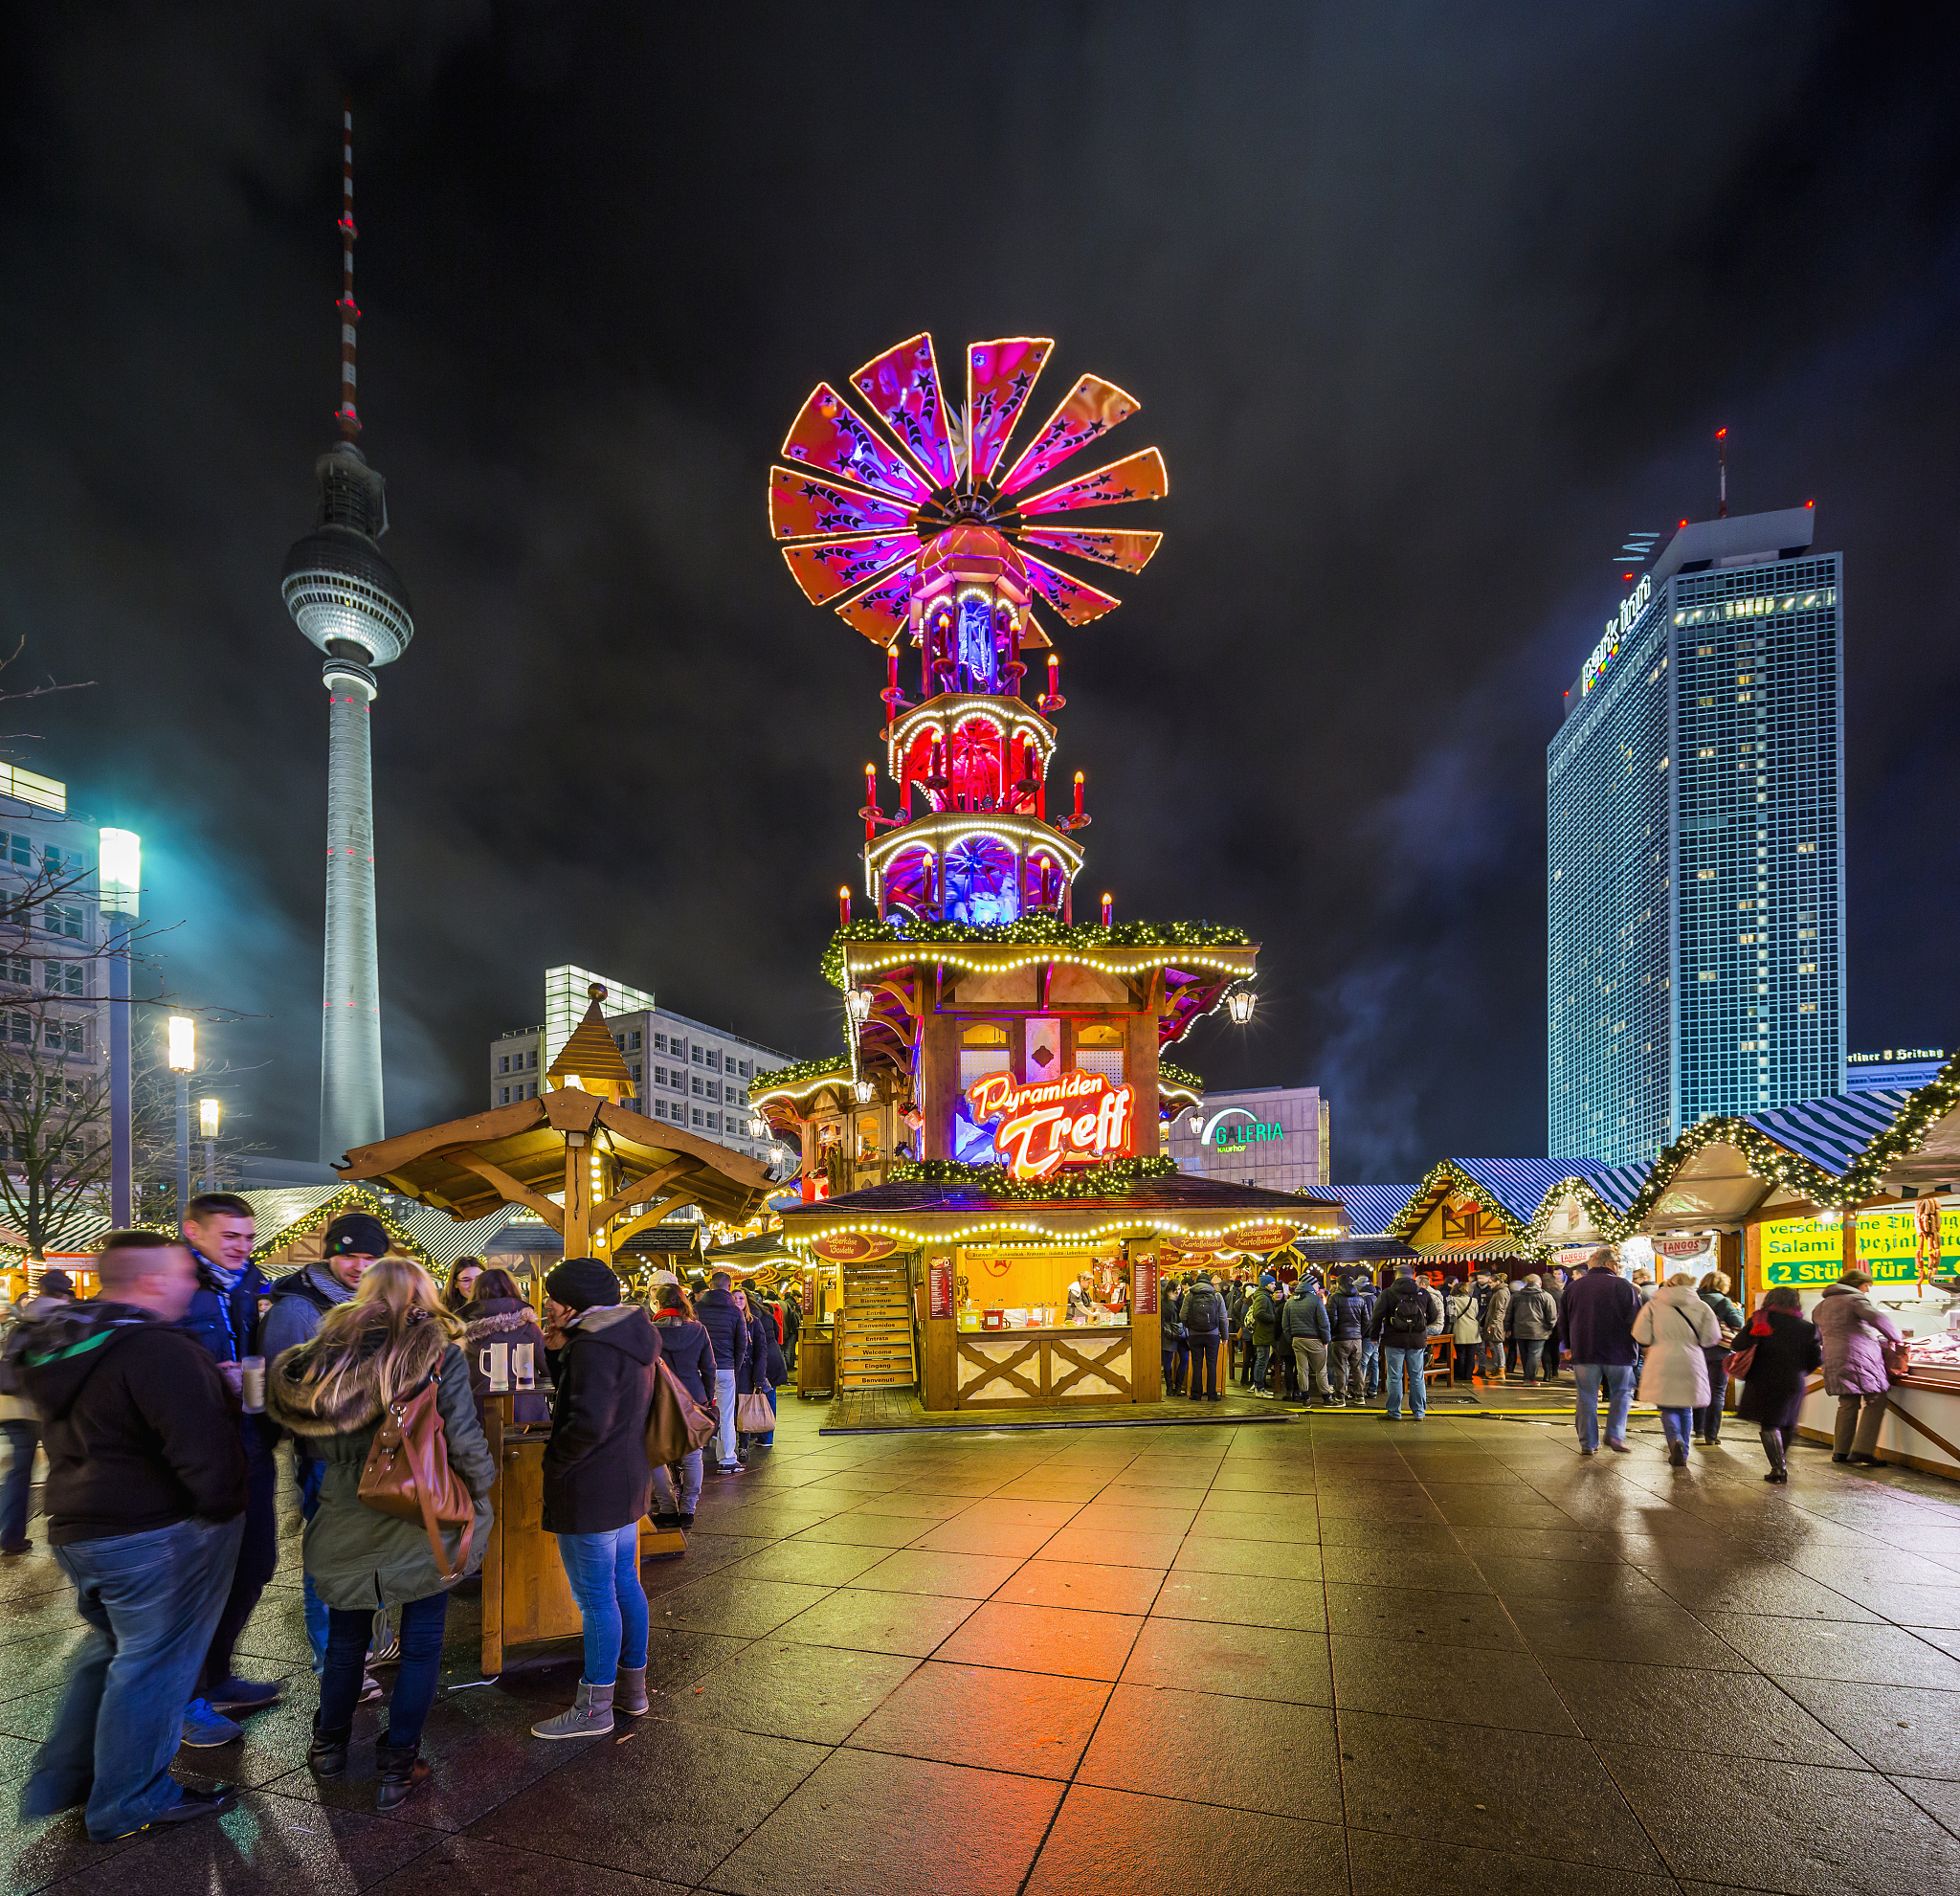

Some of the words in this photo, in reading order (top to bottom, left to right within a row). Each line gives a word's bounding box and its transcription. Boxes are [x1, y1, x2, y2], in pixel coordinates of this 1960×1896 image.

[1582, 618, 1619, 697] park
[1620, 573, 1651, 633] inn
[972, 1074, 1102, 1118] Pyramiden
[1000, 1089, 1129, 1179] Treff
[1215, 1122, 1284, 1145] GALERIA
[1236, 1225, 1282, 1238] Nackensteak
[1180, 1239, 1223, 1249] Kartoffelsalat
[1236, 1235, 1283, 1247] Kartoffelsalat
[1663, 1239, 1700, 1255] LANGOS
[1769, 1238, 1835, 1254] Salami
[1561, 1251, 1587, 1263] LANGOS
[1778, 1265, 1793, 1281] 2
[1871, 1260, 1908, 1278] für
